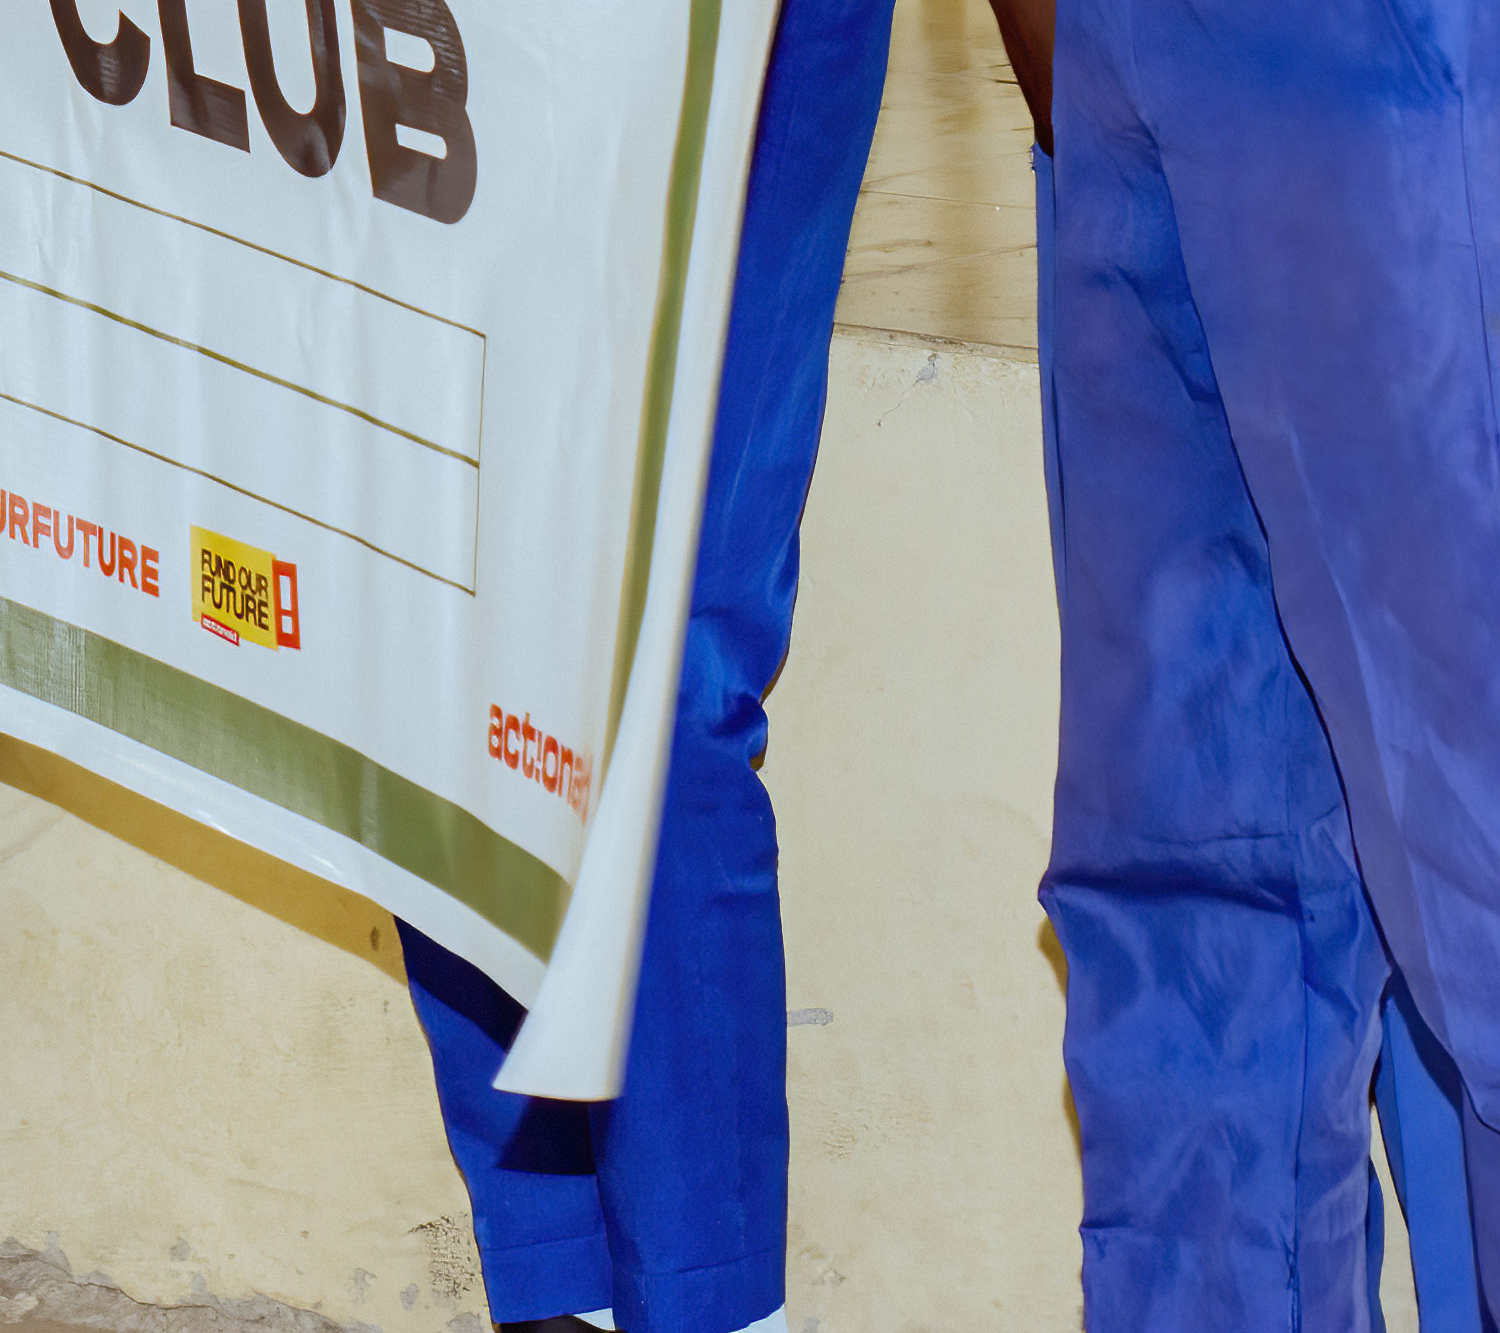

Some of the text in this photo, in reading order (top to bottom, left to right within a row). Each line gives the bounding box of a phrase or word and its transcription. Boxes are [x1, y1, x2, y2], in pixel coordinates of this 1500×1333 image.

[201, 548, 268, 600] FUND OUR
[201, 573, 270, 631] FUTURE
